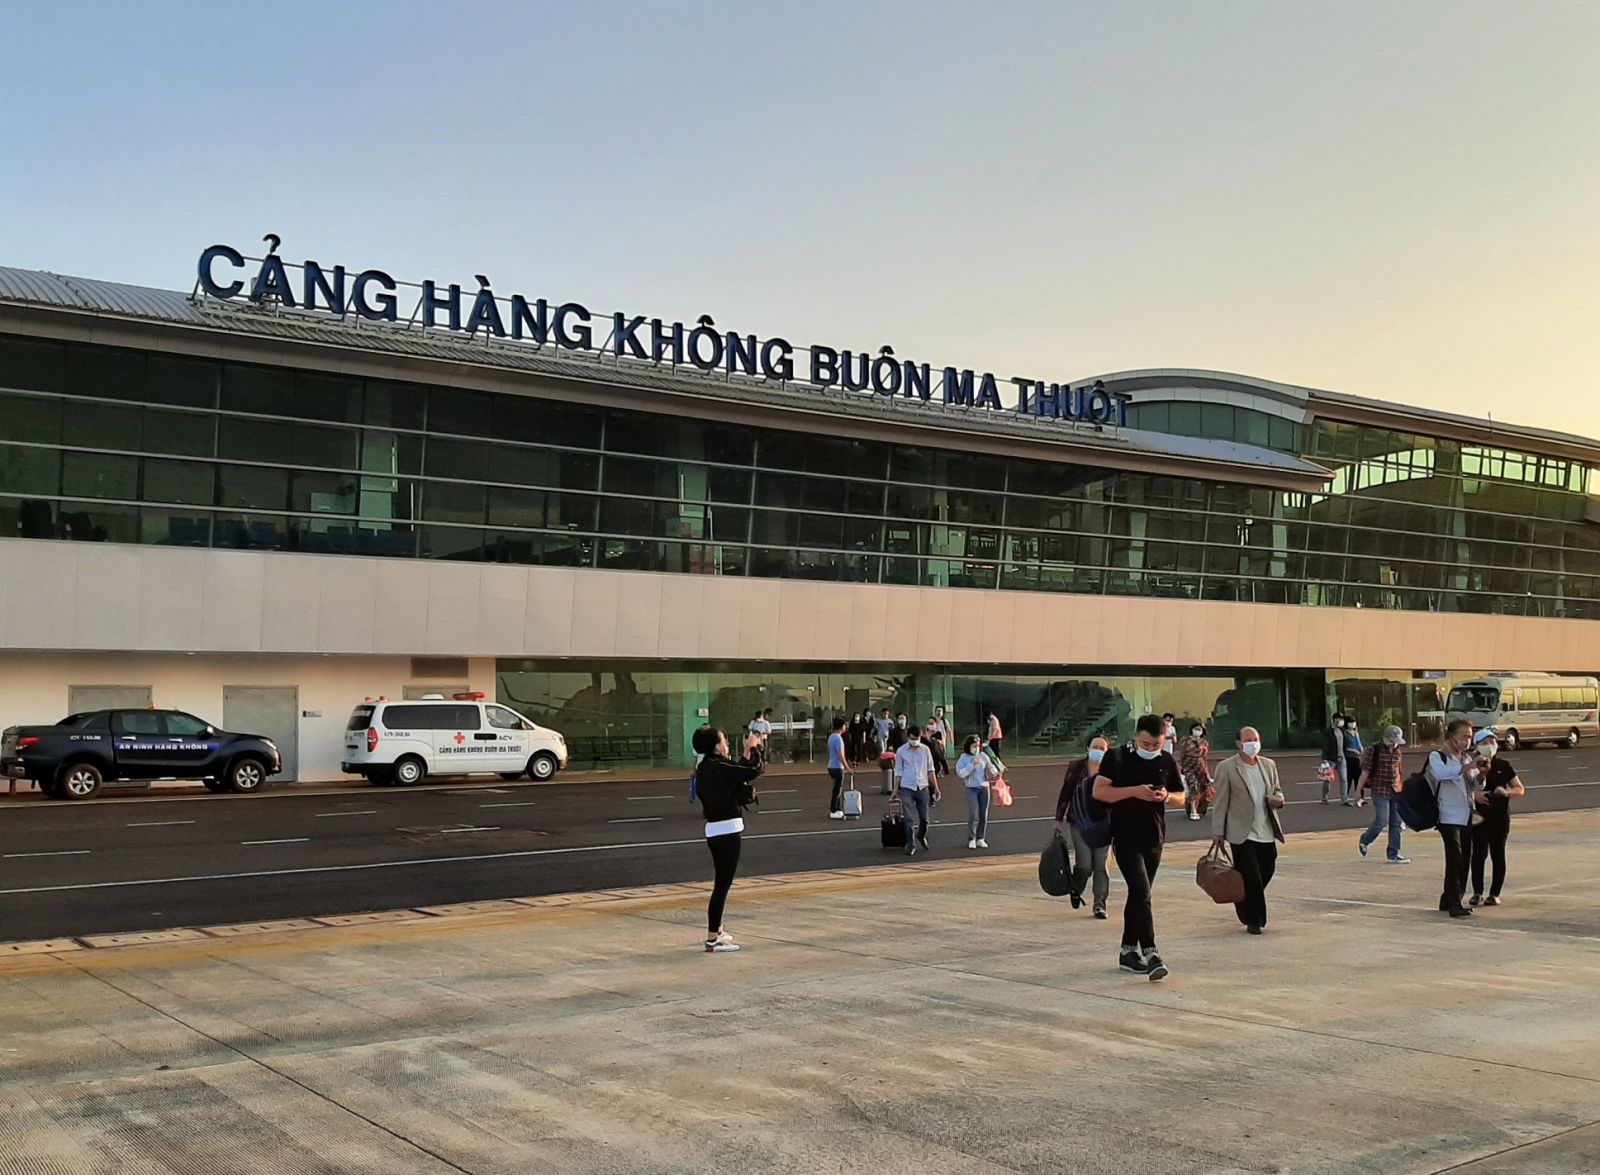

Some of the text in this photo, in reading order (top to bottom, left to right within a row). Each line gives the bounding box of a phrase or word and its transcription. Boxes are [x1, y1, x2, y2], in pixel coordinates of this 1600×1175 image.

[198, 233, 1132, 432] CẢNG HÀNG KHÔNG BUÔN MA THUỘT
[179, 742, 208, 750] KHÔNG
